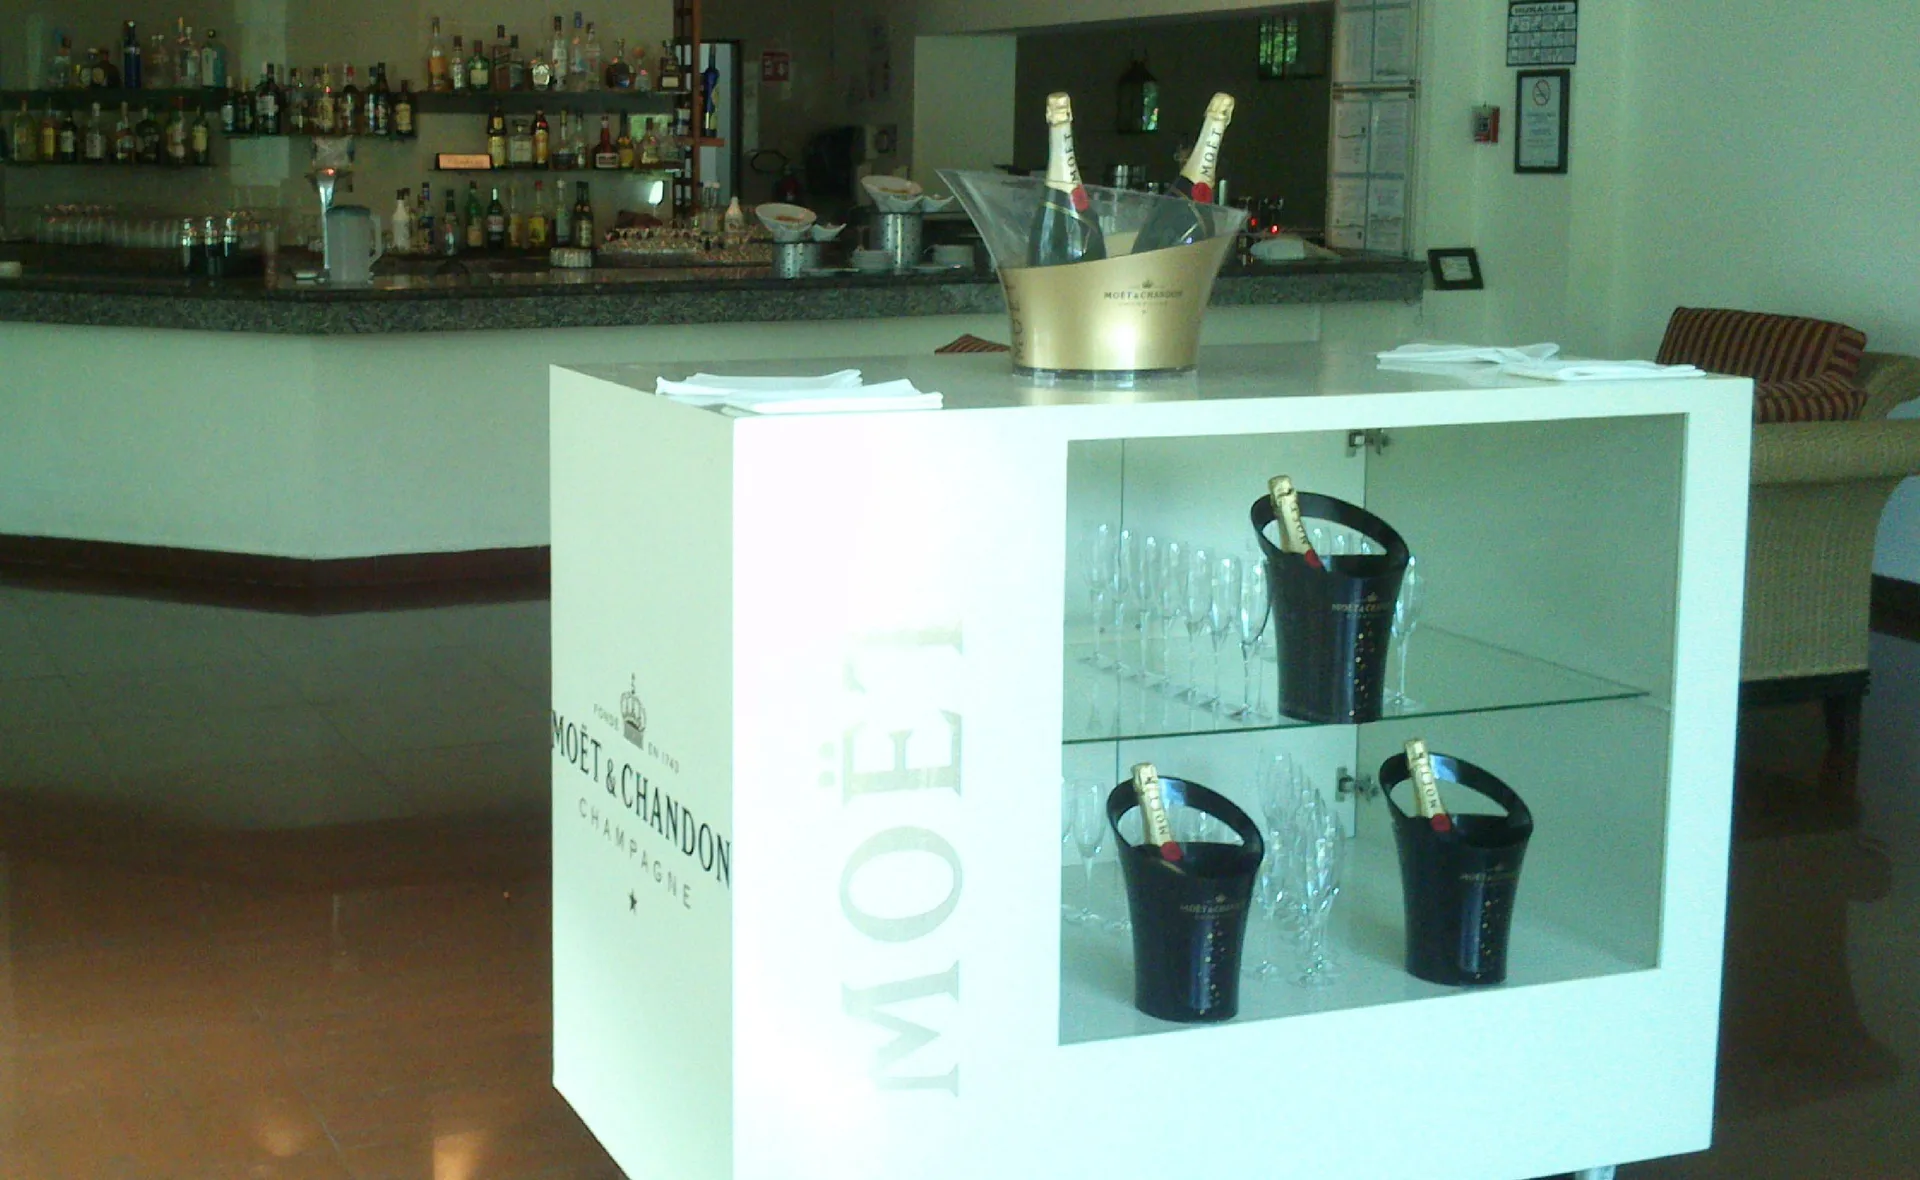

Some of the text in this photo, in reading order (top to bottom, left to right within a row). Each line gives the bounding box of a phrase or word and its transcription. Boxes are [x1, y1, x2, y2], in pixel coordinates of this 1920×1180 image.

[551, 709, 731, 889] MOËT & CHANDON
[578, 797, 692, 909] CHAMPAGNE
[817, 617, 964, 1098] MOËT
